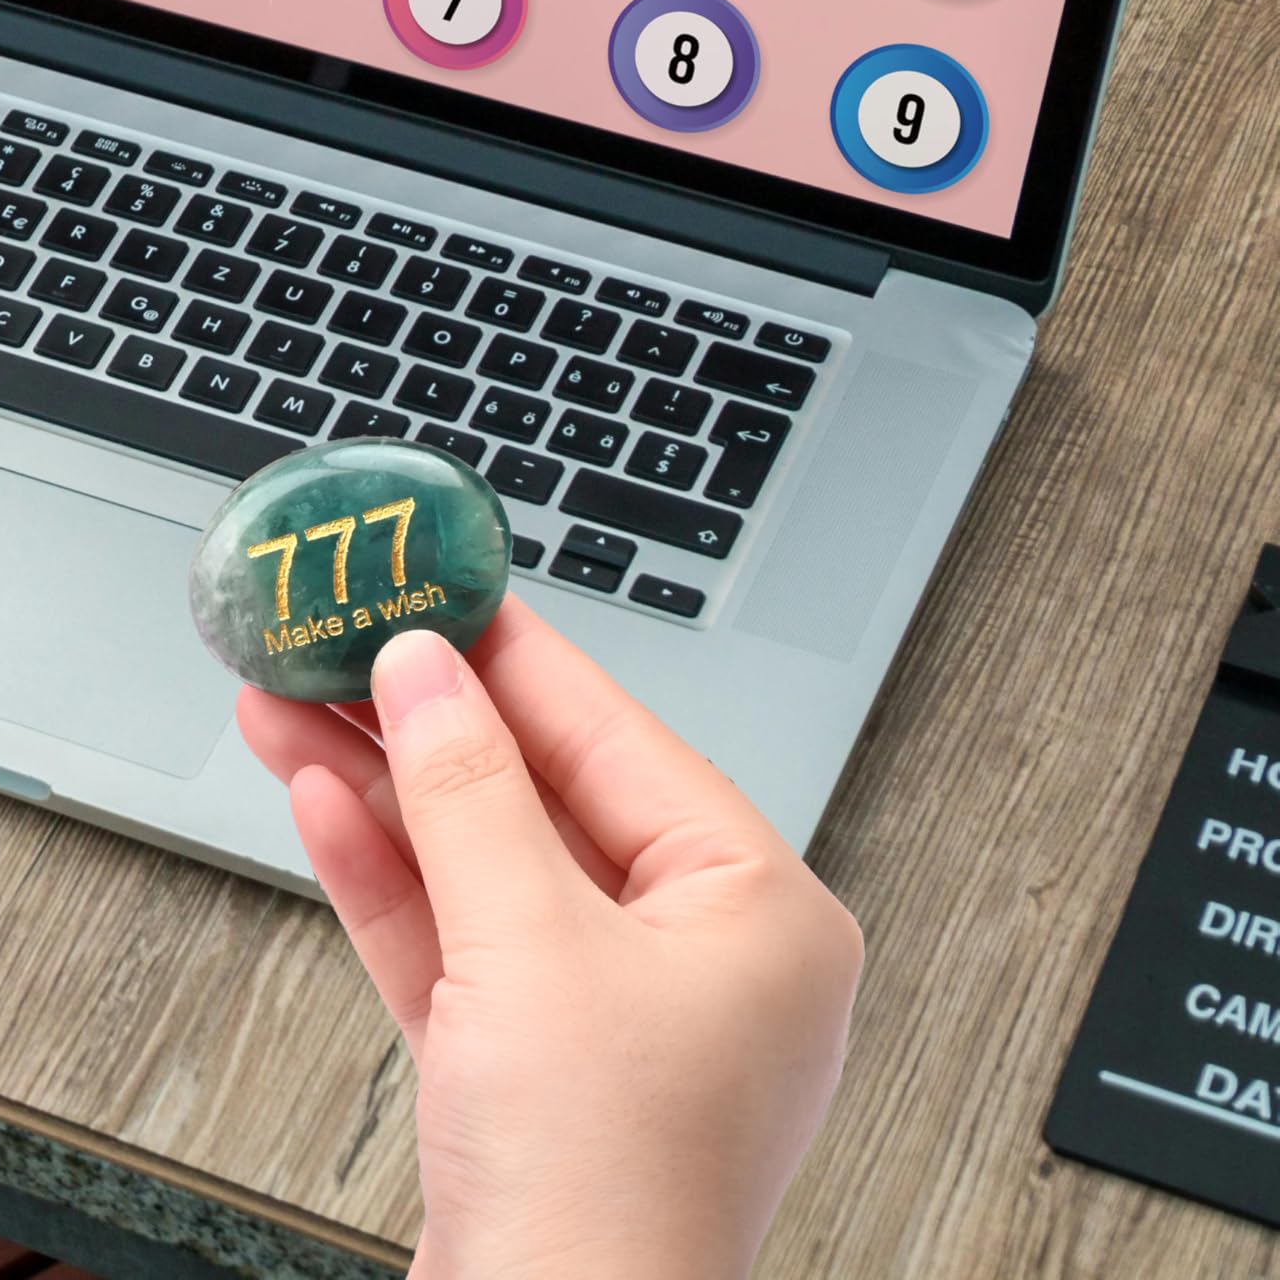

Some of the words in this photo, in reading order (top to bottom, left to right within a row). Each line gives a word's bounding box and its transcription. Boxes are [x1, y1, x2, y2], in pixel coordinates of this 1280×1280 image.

[669, 34, 699, 84] 8
[894, 94, 925, 144] 9
[62, 177, 76, 191] 4
[131, 199, 145, 211] 5
[2, 205, 18, 220] E
[71, 225, 86, 239] R
[202, 220, 214, 231] 6
[275, 239, 288, 250] 7
[145, 246, 157, 258] T
[213, 266, 230, 280] Z
[347, 261, 360, 272] 8
[61, 276, 75, 287] F
[422, 282, 433, 293] 9
[286, 287, 303, 300] U
[131, 297, 149, 312] G
[495, 304, 508, 315] 0
[363, 310, 371, 322] I
[202, 317, 221, 332] H
[69, 331, 83, 345] V
[434, 331, 451, 344] O
[278, 340, 291, 352] J
[139, 354, 153, 367] B
[510, 352, 526, 364] P
[351, 361, 368, 376] K
[210, 375, 229, 390] N
[427, 383, 437, 397] L
[282, 397, 304, 413] M
[247, 497, 416, 621] 777
[262, 615, 344, 655] Make
[352, 608, 373, 630] a
[377, 581, 447, 622] wish
[1198, 901, 1280, 956] DIR
[1196, 1063, 1280, 1121] DA
